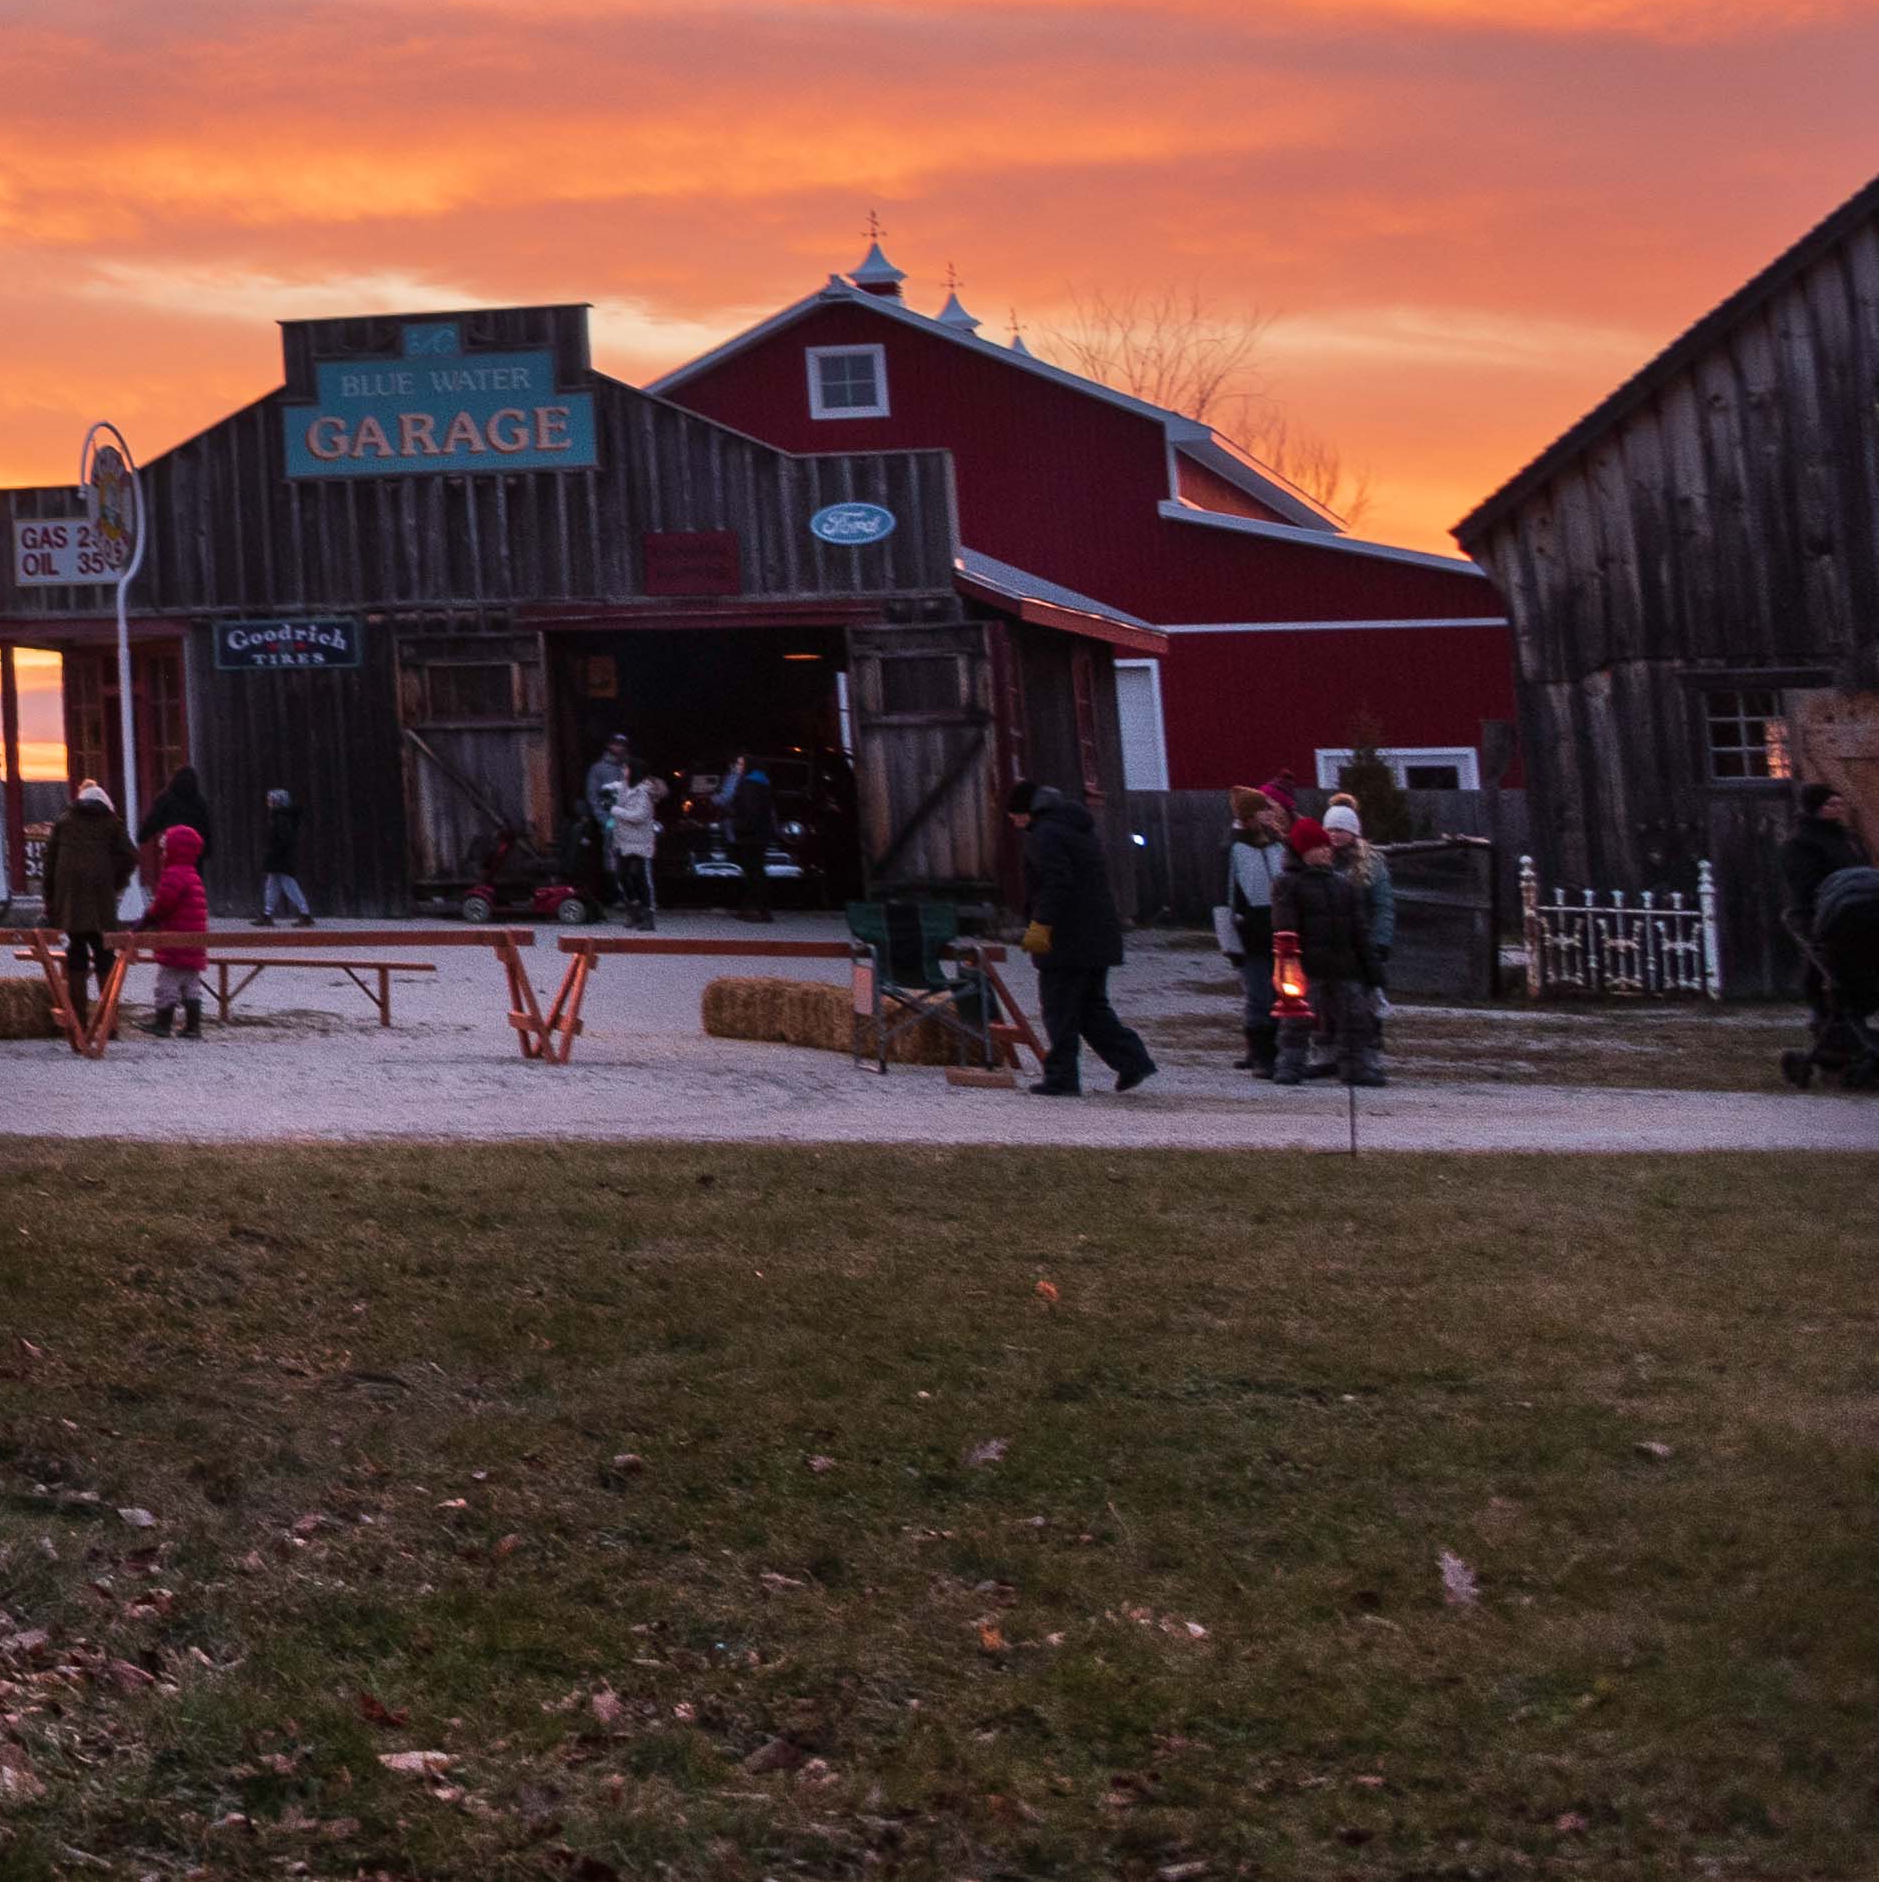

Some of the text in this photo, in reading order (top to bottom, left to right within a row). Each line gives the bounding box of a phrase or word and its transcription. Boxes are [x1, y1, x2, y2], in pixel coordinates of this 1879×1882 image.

[342, 367, 533, 398] BLUE WATER
[305, 406, 573, 461] GARAGE
[821, 509, 883, 535] Ford
[21, 525, 69, 550] GAS
[21, 552, 60, 576] OIL
[226, 623, 347, 651] Goodrich
[251, 652, 326, 665] TIRES
